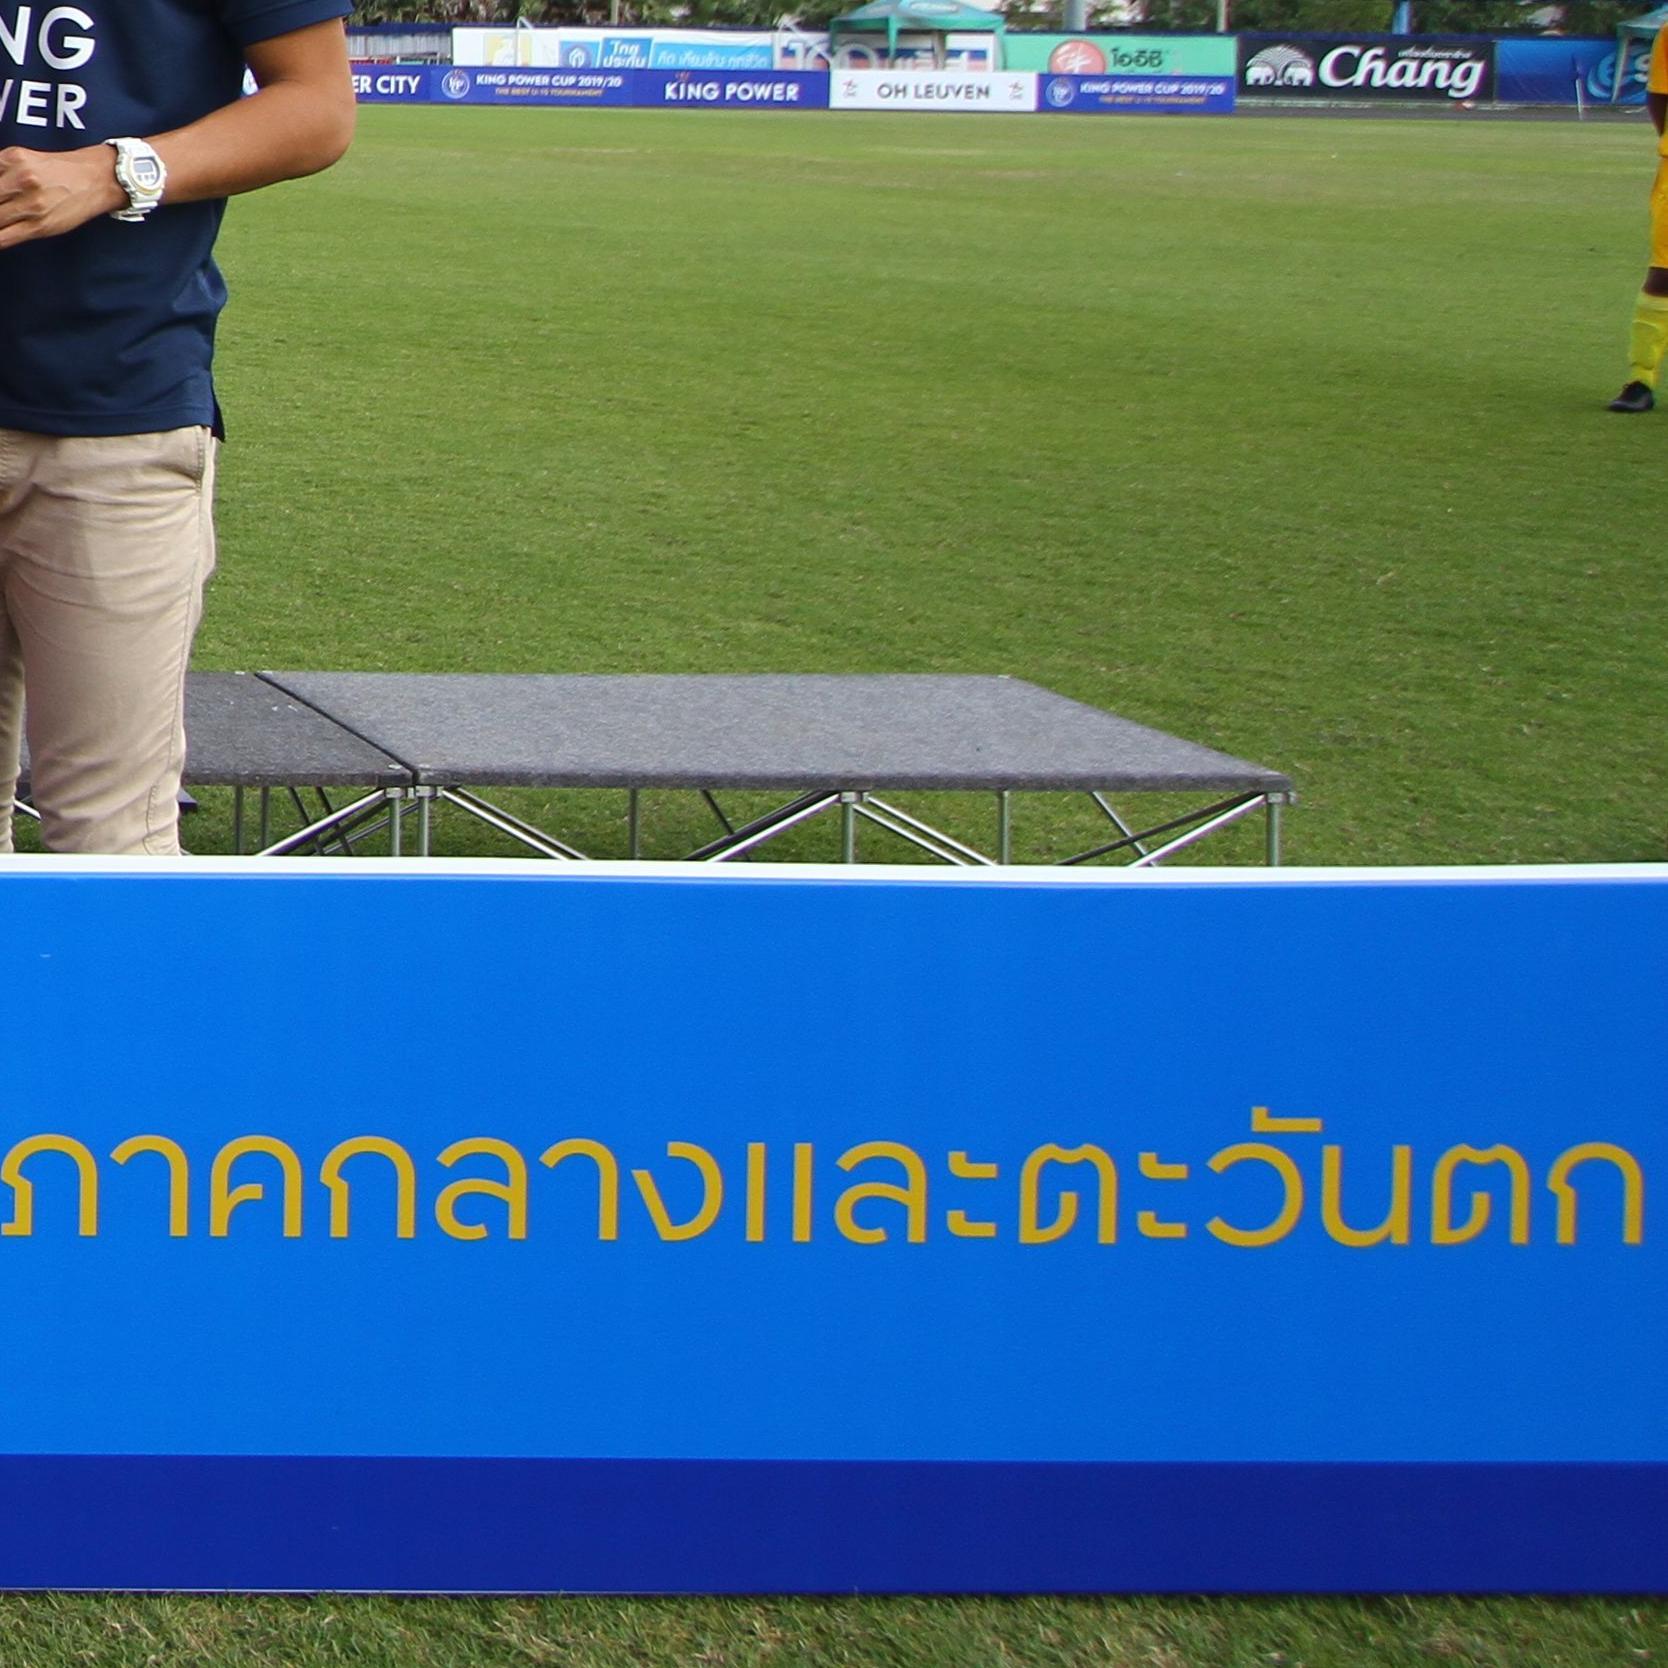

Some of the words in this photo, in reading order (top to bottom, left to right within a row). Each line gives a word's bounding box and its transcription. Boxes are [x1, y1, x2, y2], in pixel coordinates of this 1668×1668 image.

[476, 73, 507, 86] KING
[508, 74, 550, 87] POWER
[551, 75, 577, 88] CUP
[577, 75, 624, 89] 2019/20
[1317, 44, 1486, 99] Chang
[376, 74, 422, 95] CITY
[665, 82, 719, 101] KING
[725, 83, 800, 102] POWER
[877, 83, 907, 99] OH
[914, 83, 990, 101] LEUVEN
